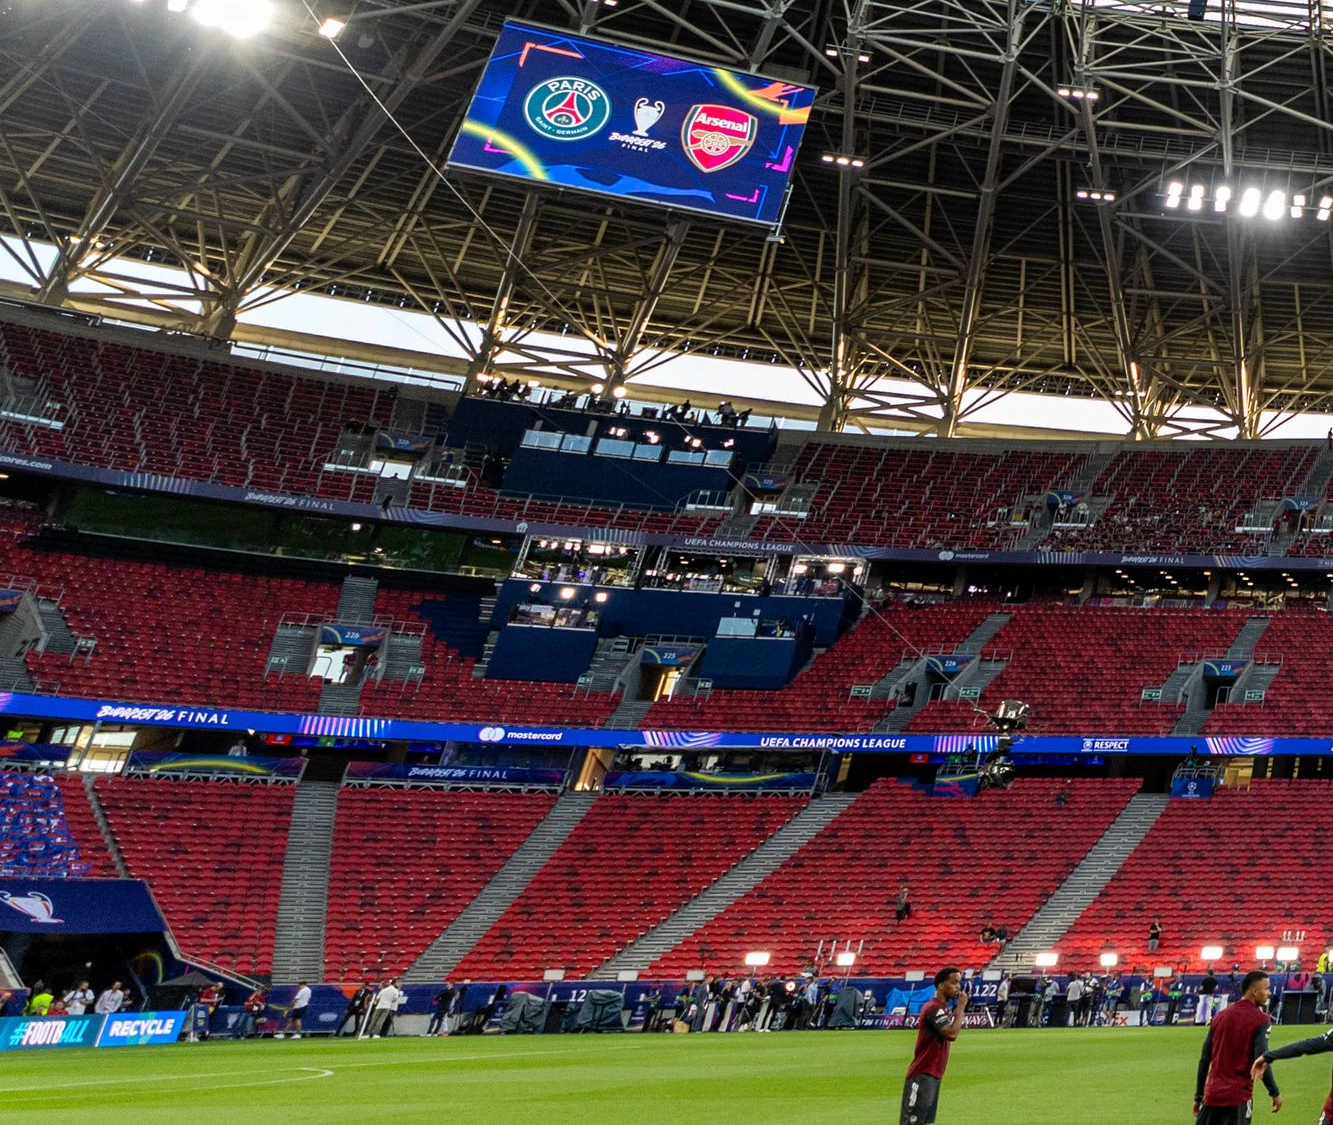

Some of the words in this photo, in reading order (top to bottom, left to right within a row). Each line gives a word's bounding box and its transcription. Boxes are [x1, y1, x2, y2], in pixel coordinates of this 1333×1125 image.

[547, 79, 602, 103] PARIS
[695, 112, 748, 133] Arsenal
[621, 143, 649, 153] FINAL
[0, 454, 53, 470] cores.com
[299, 499, 335, 511] FINAL
[685, 538, 707, 546] UEFA
[709, 540, 759, 550] CHAMPIONS
[760, 542, 794, 552] LEAGUE
[1159, 556, 1185, 564] FINAL
[97, 705, 157, 721] BUDAPEST
[177, 711, 229, 725] FINAL
[507, 731, 563, 740] mastercard
[761, 737, 789, 747] UEFA
[793, 737, 860, 748] CHAMPIONS
[862, 738, 906, 748] LEAGUE
[1094, 741, 1128, 750] RESPECT
[468, 769, 508, 779] FINAL
[568, 988, 588, 1002] 12
[973, 984, 997, 997] 122
[10, 1019, 90, 1047] #FOOTBALL
[109, 1018, 175, 1037] RECYCLE
